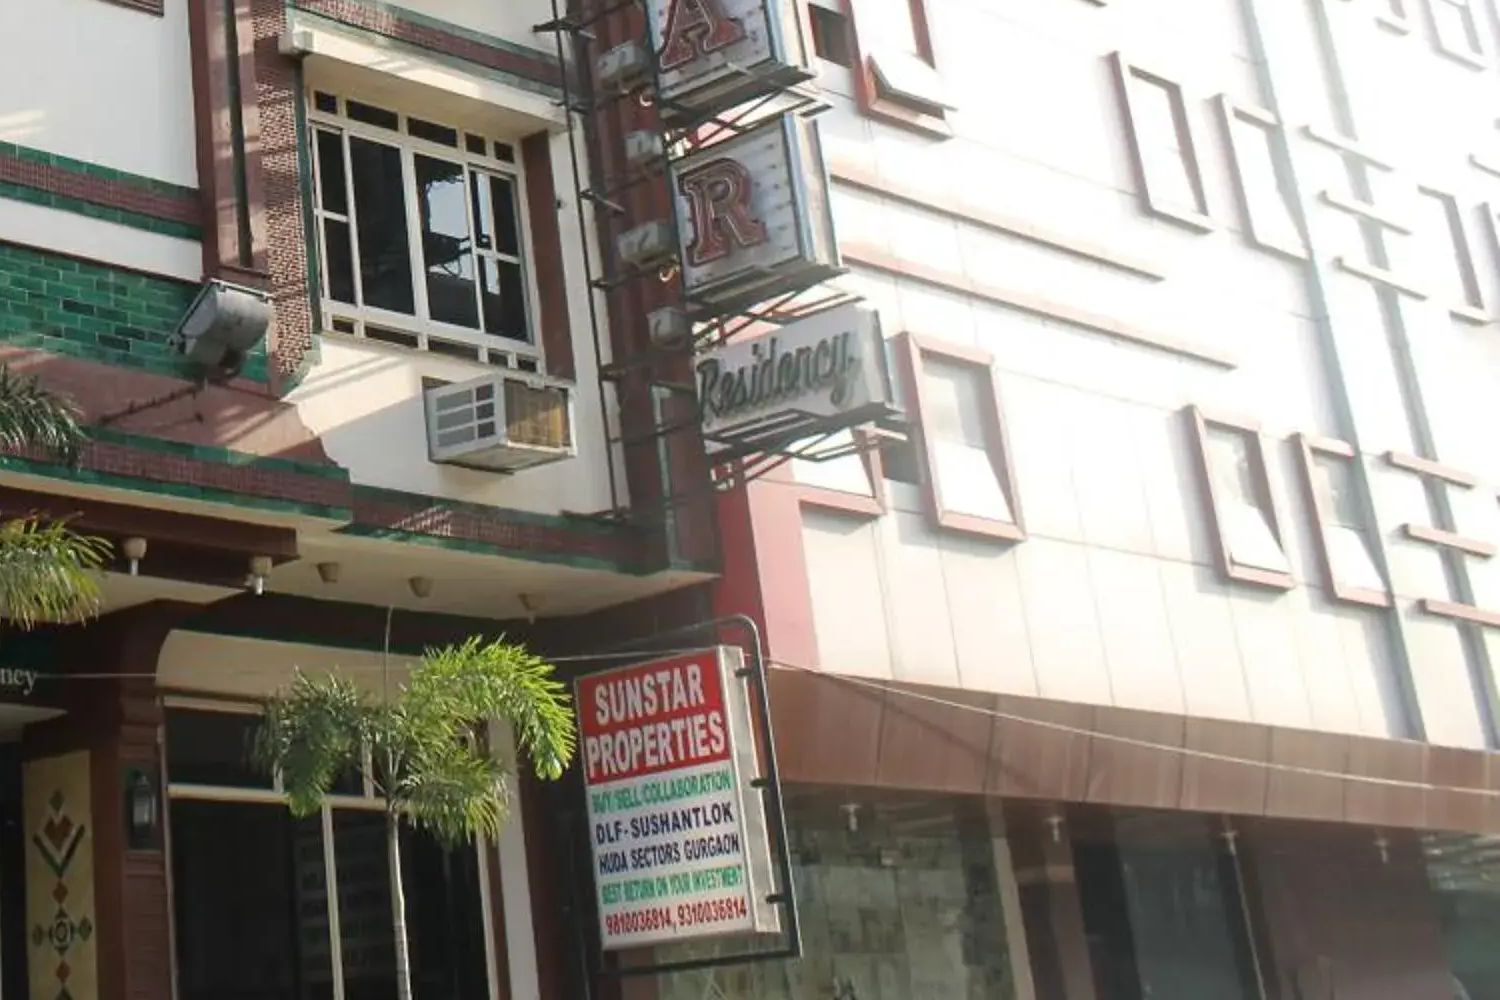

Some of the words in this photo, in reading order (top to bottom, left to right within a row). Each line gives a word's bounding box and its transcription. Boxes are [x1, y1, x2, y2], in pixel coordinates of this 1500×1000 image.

[696, 331, 860, 426] Residency
[595, 663, 705, 726] SUNSTAR
[586, 710, 726, 779] PROPERTIES
[631, 841, 681, 870] SECTORS
[684, 833, 741, 861] GURGAON
